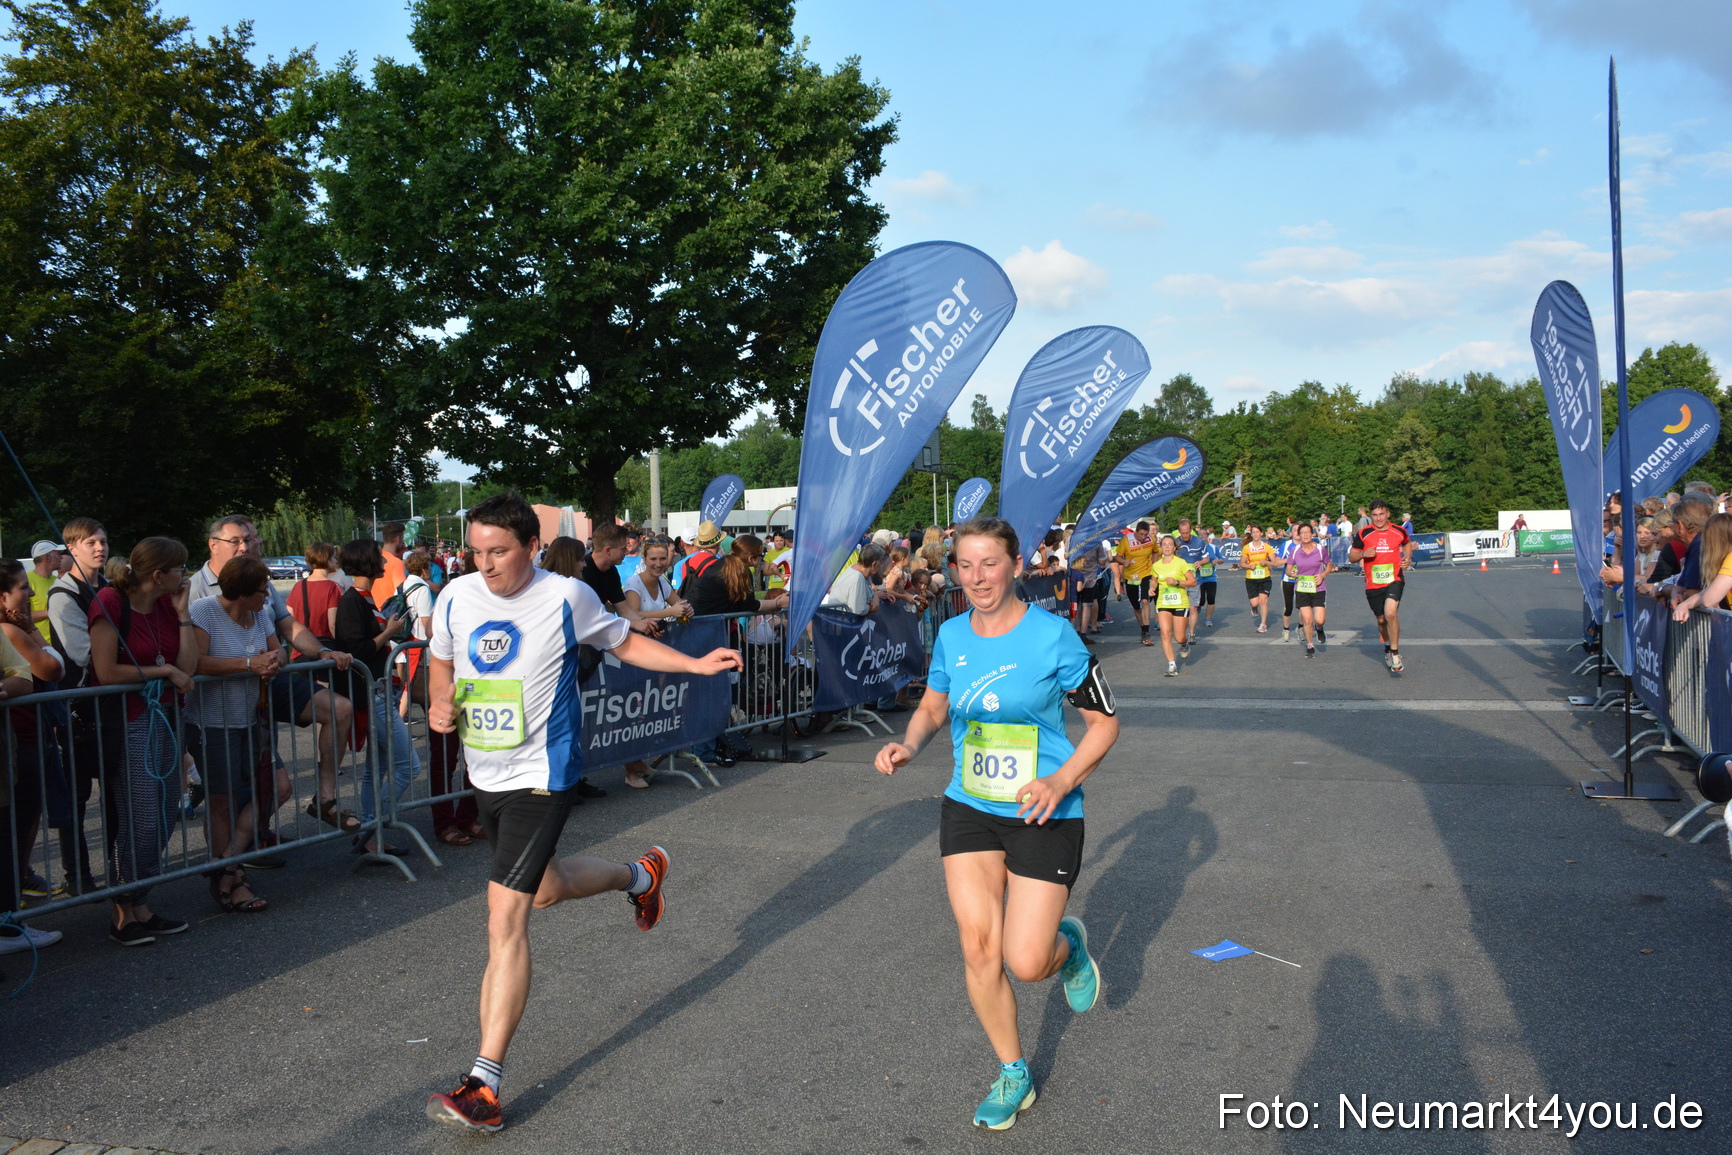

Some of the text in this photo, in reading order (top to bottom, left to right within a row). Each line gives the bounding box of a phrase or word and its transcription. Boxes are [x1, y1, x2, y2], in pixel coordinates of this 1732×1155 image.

[856, 277, 970, 430] Fischer
[897, 306, 984, 429] AUTOMOBILE
[1039, 349, 1117, 460] Fischer
[1067, 369, 1128, 458] AUTOMOBILE
[1650, 423, 1711, 480] Druck und Medien
[710, 481, 735, 518] Fischer
[962, 483, 984, 514] Fischer
[1089, 471, 1172, 522] Frischmann
[1142, 486, 1162, 501] Druck
[1176, 465, 1199, 484] Medien
[1375, 571, 1390, 579] 959
[481, 638, 509, 651] TÜV
[581, 679, 689, 728] Fischer
[956, 662, 1017, 709] Team Schick Bau
[460, 707, 515, 731] 1592
[589, 715, 682, 750] AUTOMOBILE
[972, 752, 1018, 780] 803
